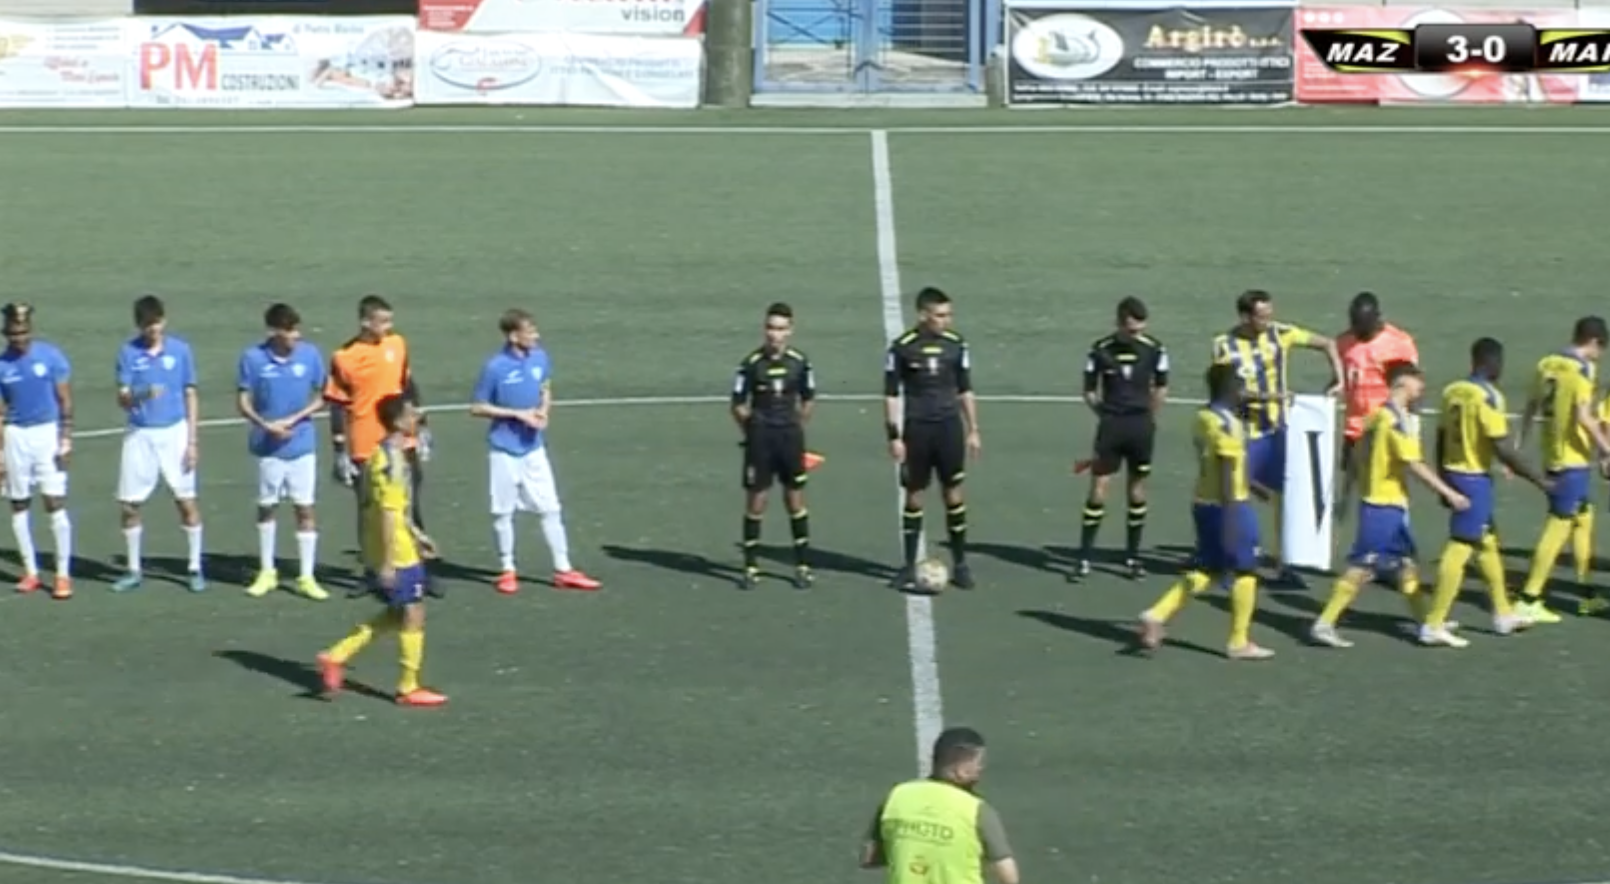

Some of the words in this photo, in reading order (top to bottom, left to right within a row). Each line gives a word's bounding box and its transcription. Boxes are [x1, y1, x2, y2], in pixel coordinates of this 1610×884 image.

[621, 8, 685, 22] vision
[140, 42, 217, 91] PM
[1164, 69, 1206, 80] IMPORT
[1215, 69, 1258, 79] EXPORT
[221, 73, 301, 91] COSTRUZIONI
